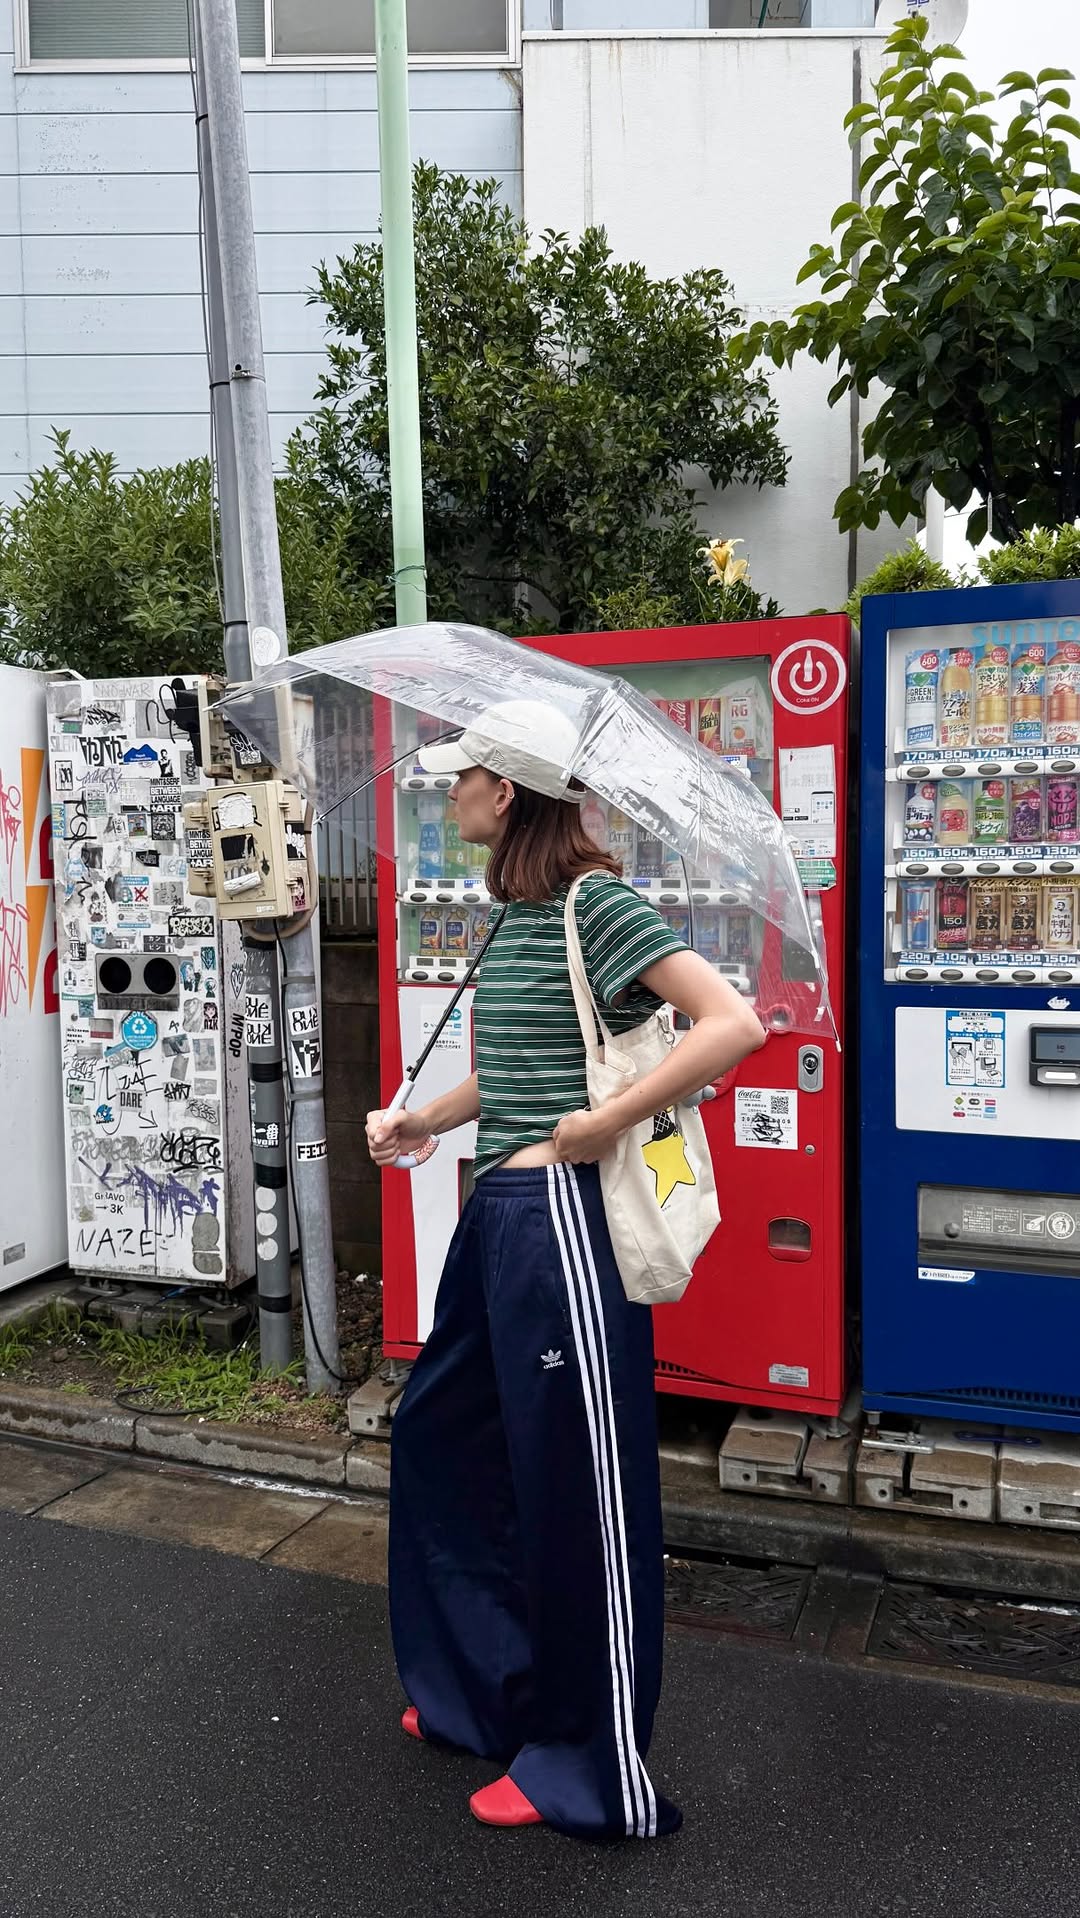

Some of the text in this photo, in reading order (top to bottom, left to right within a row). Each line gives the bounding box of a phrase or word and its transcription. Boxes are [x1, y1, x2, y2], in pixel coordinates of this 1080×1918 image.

[1029, 649, 1044, 657] 600
[921, 657, 937, 666] 600
[123, 682, 151, 697] WAR
[910, 688, 931, 696] GREEN
[1016, 682, 1039, 695] 麦茶
[905, 747, 1079, 761] 170円 180円 170円 140円 160円
[151, 787, 180, 795] BETWEEN
[904, 847, 1077, 857] 160円 160円 160円 160円 130円
[943, 917, 962, 925] 150
[901, 952, 930, 961] 220円
[936, 953, 967, 961] 210円
[977, 953, 1007, 961] 150円
[1009, 954, 1041, 962] 150円
[1045, 955, 1076, 963] 150円
[229, 1013, 244, 1057] M'POP
[120, 1091, 143, 1108] DARE
[110, 1203, 124, 1215] 3K
[543, 1360, 565, 1370] adidas
